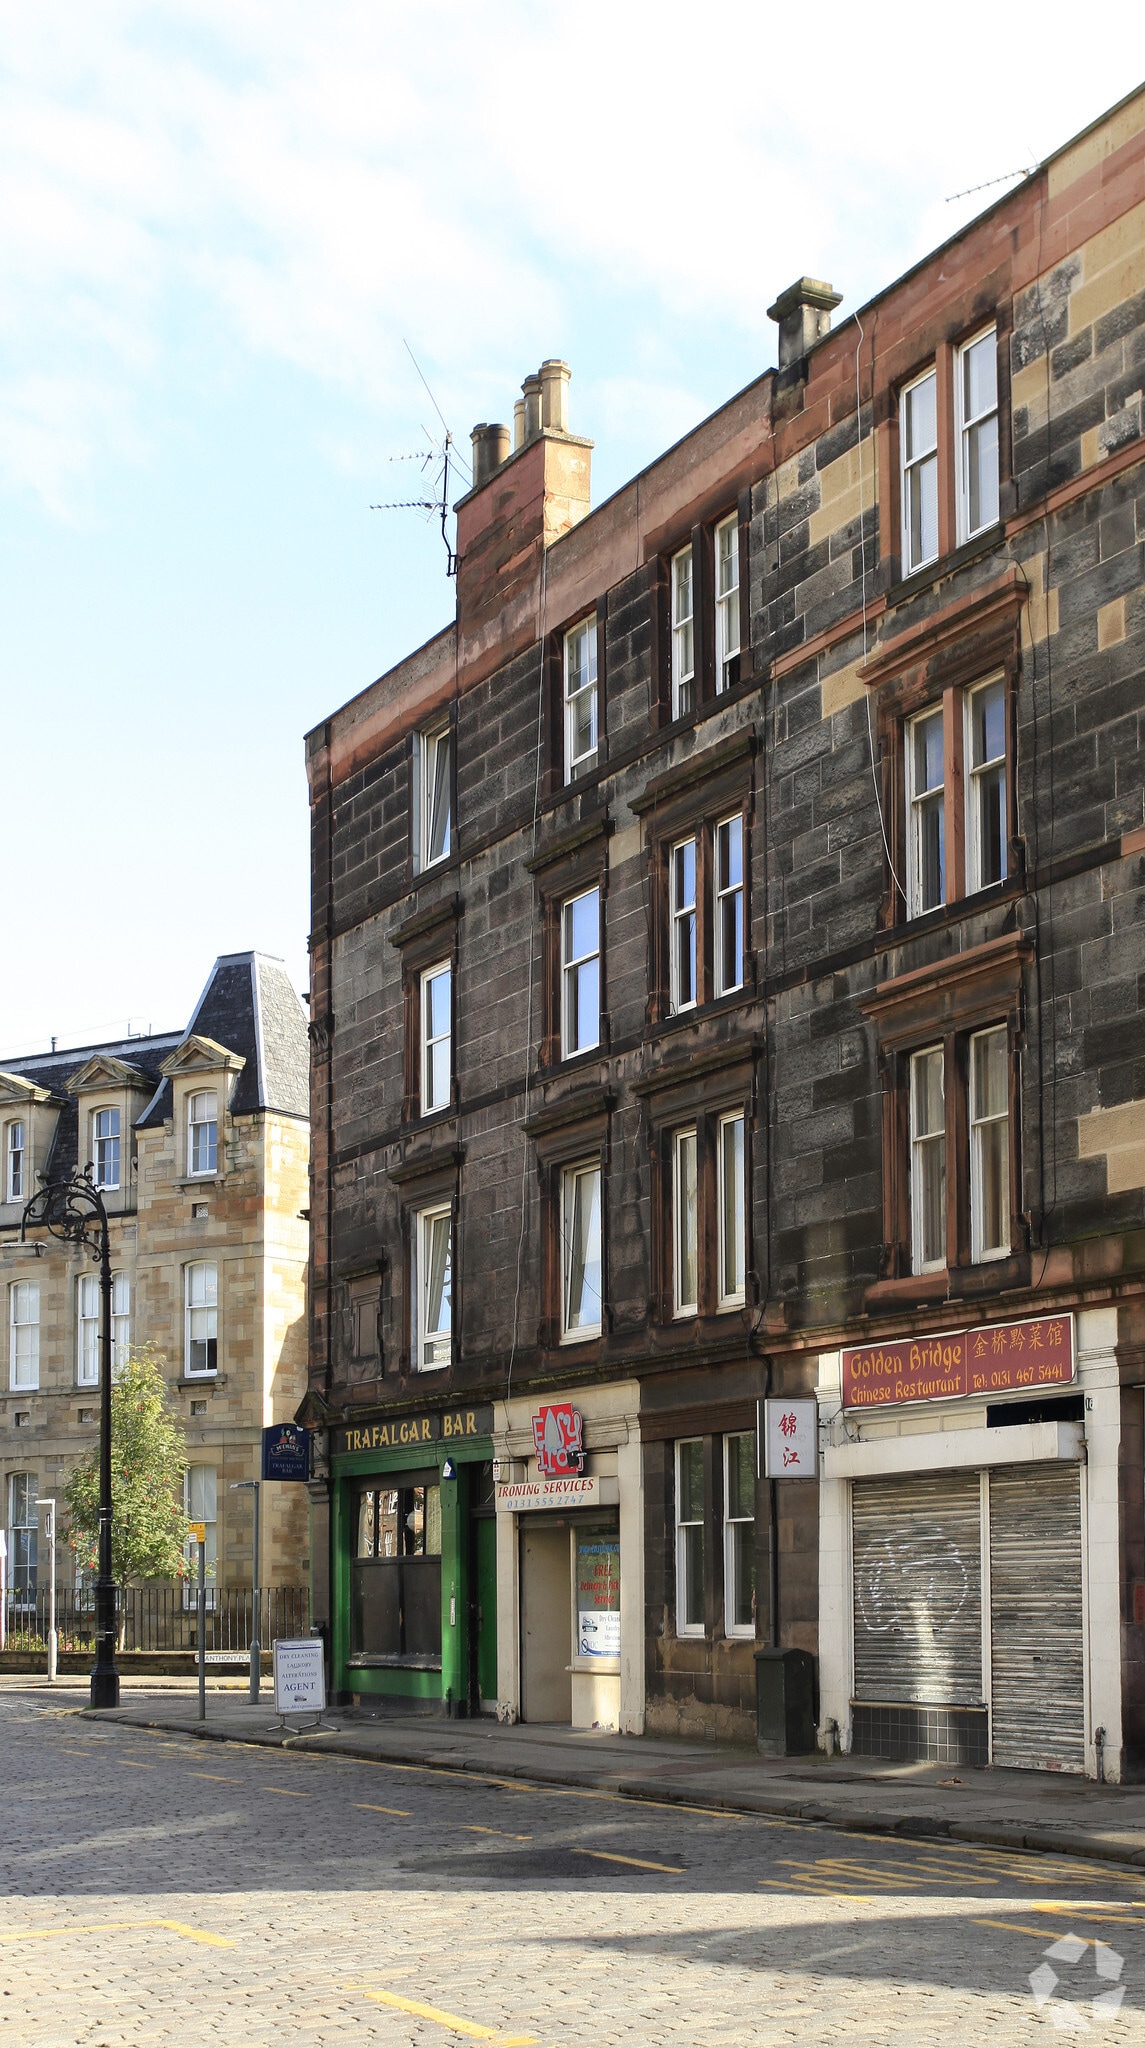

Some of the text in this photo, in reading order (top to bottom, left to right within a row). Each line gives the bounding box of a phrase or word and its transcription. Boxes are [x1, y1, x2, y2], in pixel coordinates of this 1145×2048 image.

[850, 1341, 962, 1379] Golden Bridge
[972, 1363, 1063, 1389] Tel: 0131 467 5441
[850, 1373, 961, 1404] Chinese Restaurant
[345, 1412, 477, 1450] TRAFALGAR BAR
[498, 1479, 594, 1498] IRONING SERVICES
[507, 1494, 584, 1509] 0131 555 2747
[593, 1564, 613, 1577] FREE
[283, 1682, 316, 1692] AGENT
